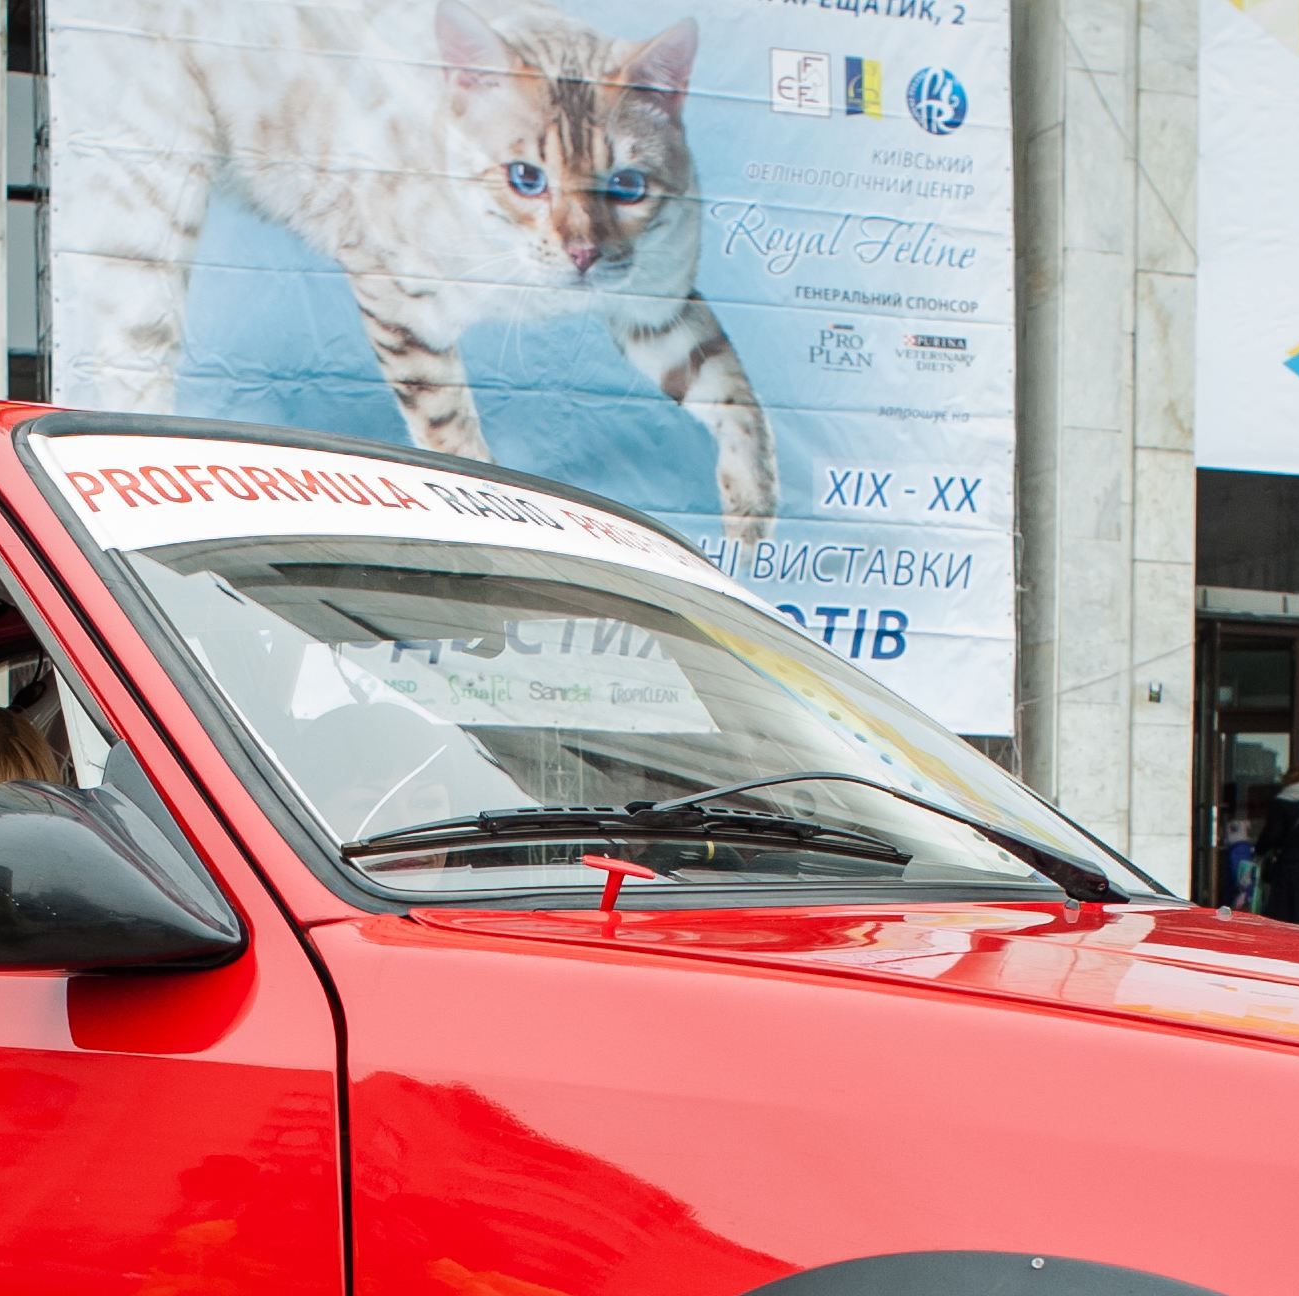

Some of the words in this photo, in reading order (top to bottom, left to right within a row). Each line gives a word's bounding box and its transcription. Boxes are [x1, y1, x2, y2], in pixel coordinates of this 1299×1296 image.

[951, 4, 966, 25] 2
[745, 163, 911, 190] ФЕЛІНОЛОГІЧНИЙ
[916, 178, 975, 200] ЦЕНТР
[872, 149, 973, 174] КИЇВСЬКИЙ
[710, 202, 851, 275] Royal
[854, 215, 977, 270] Feline
[795, 286, 902, 308] ГЕНЕРАЛЬНИЙ
[906, 296, 979, 313] СПОНСОР
[67, 464, 430, 514] PROFORMULA
[422, 480, 565, 531] RADIO
[825, 470, 893, 507] XIX
[928, 476, 982, 513] XX
[753, 542, 974, 589] ВИСТАВКИ
